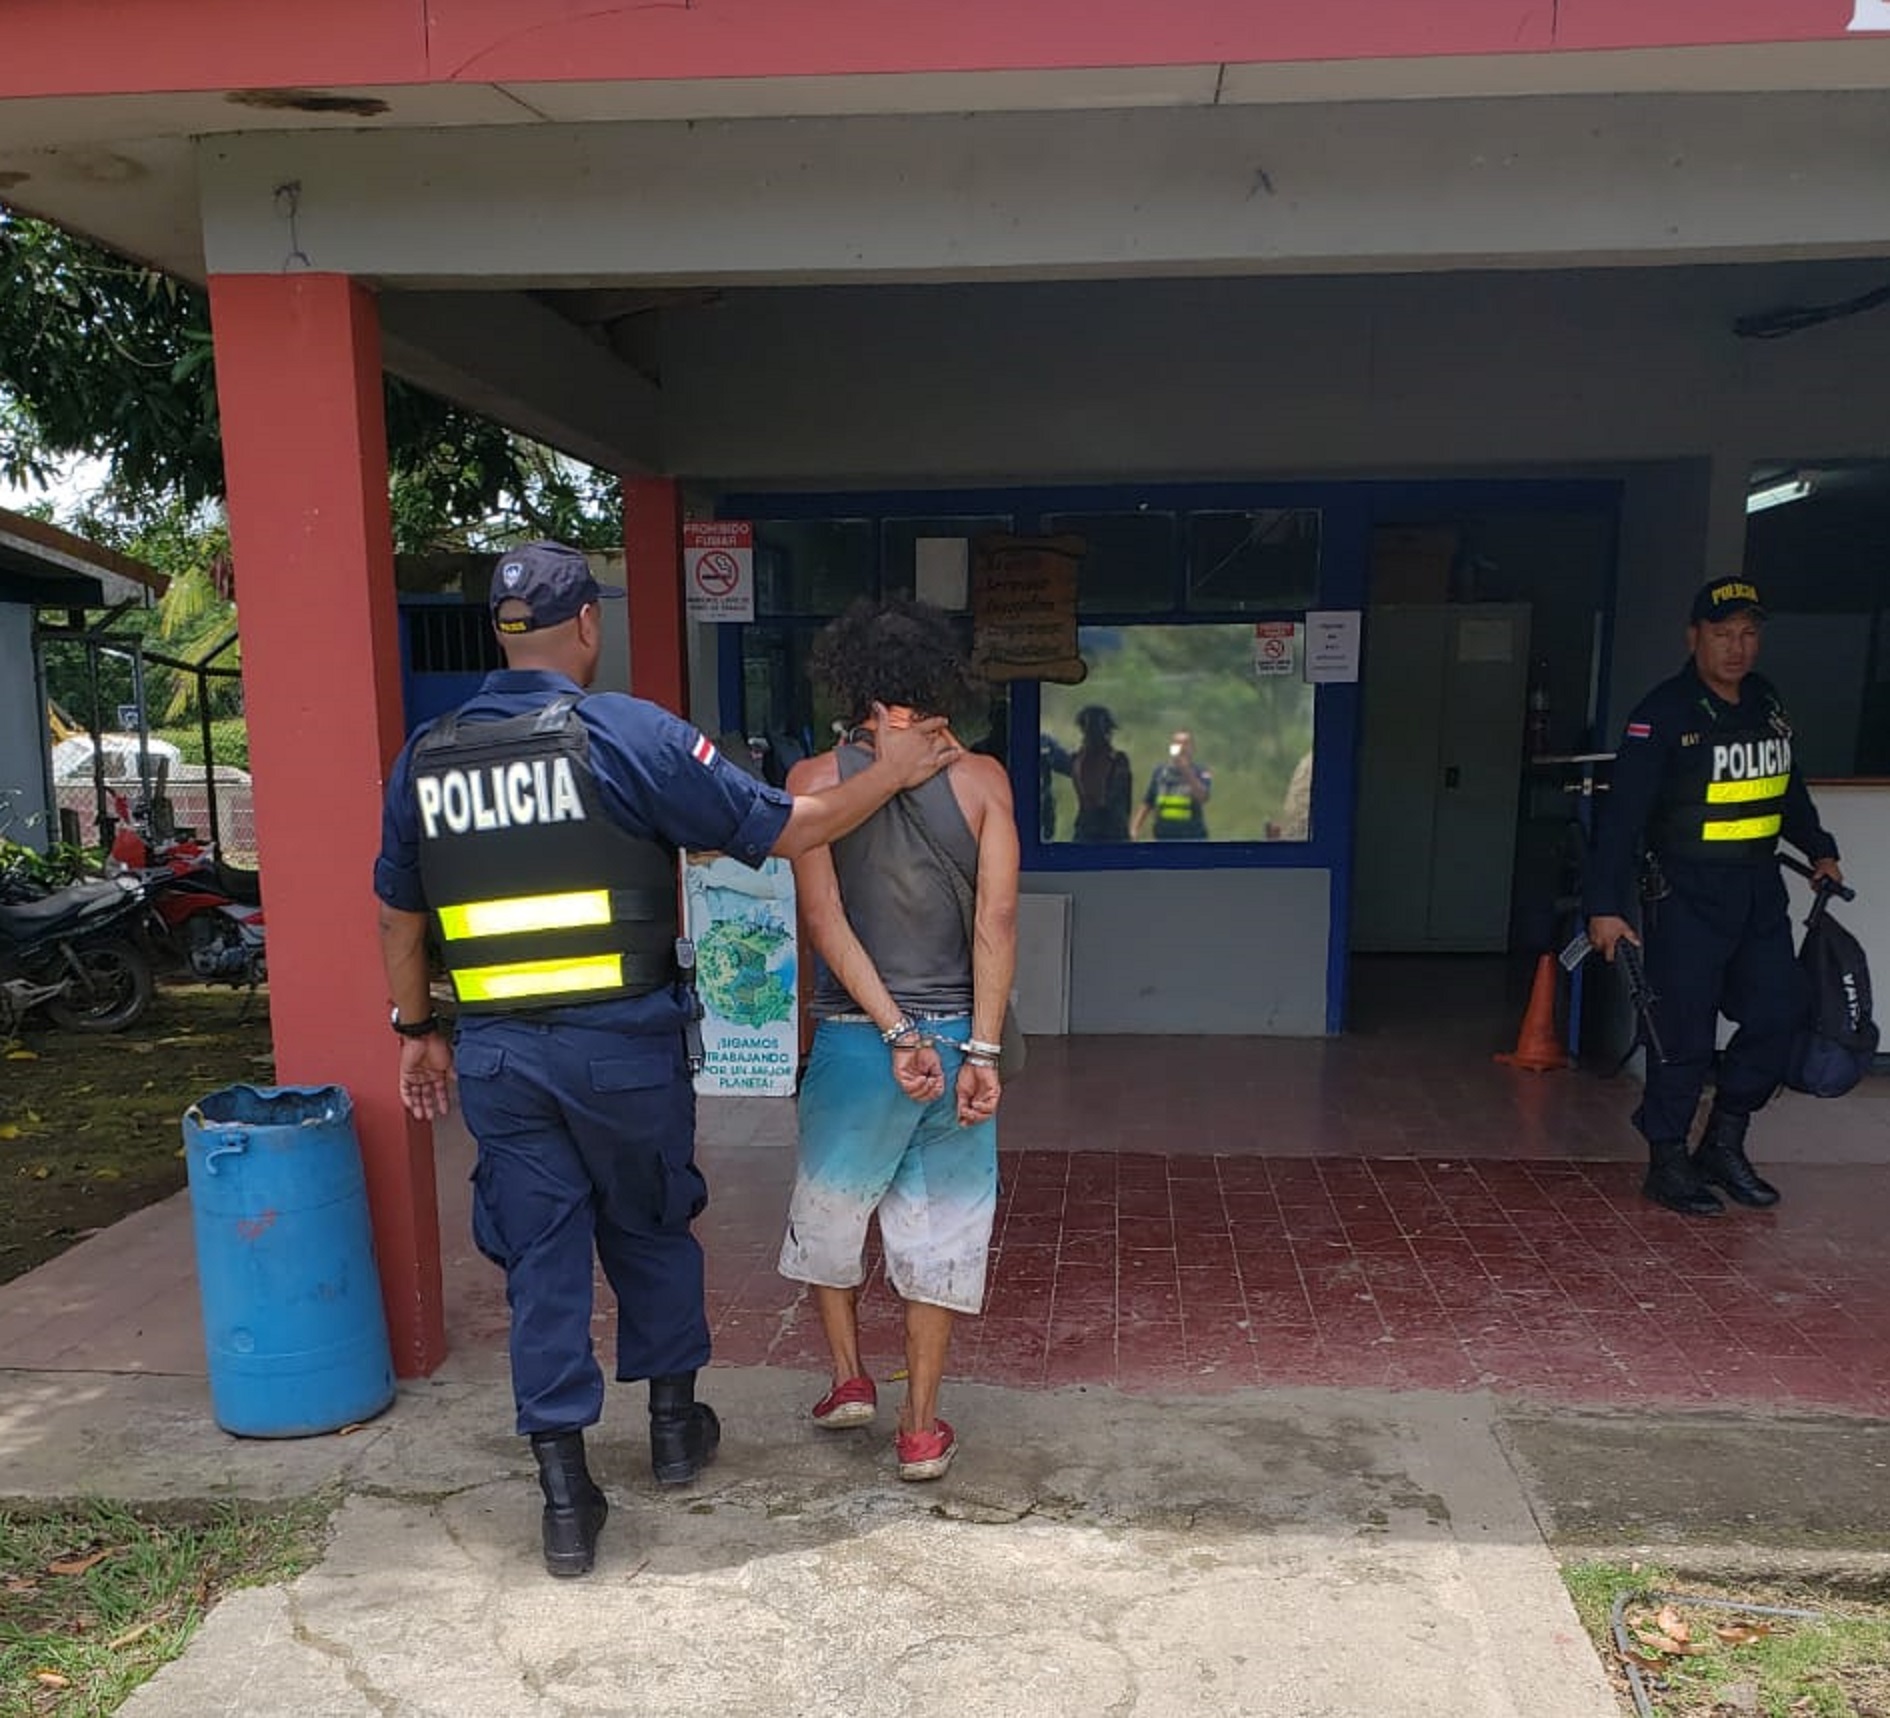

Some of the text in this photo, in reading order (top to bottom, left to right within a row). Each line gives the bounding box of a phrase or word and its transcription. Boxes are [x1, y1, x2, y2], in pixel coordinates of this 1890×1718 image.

[1711, 583, 1759, 606] POLICIA
[1713, 738, 1792, 782] POLICIA
[416, 756, 586, 839] POLICIA
[705, 1050, 789, 1063] TRABAJANDO
